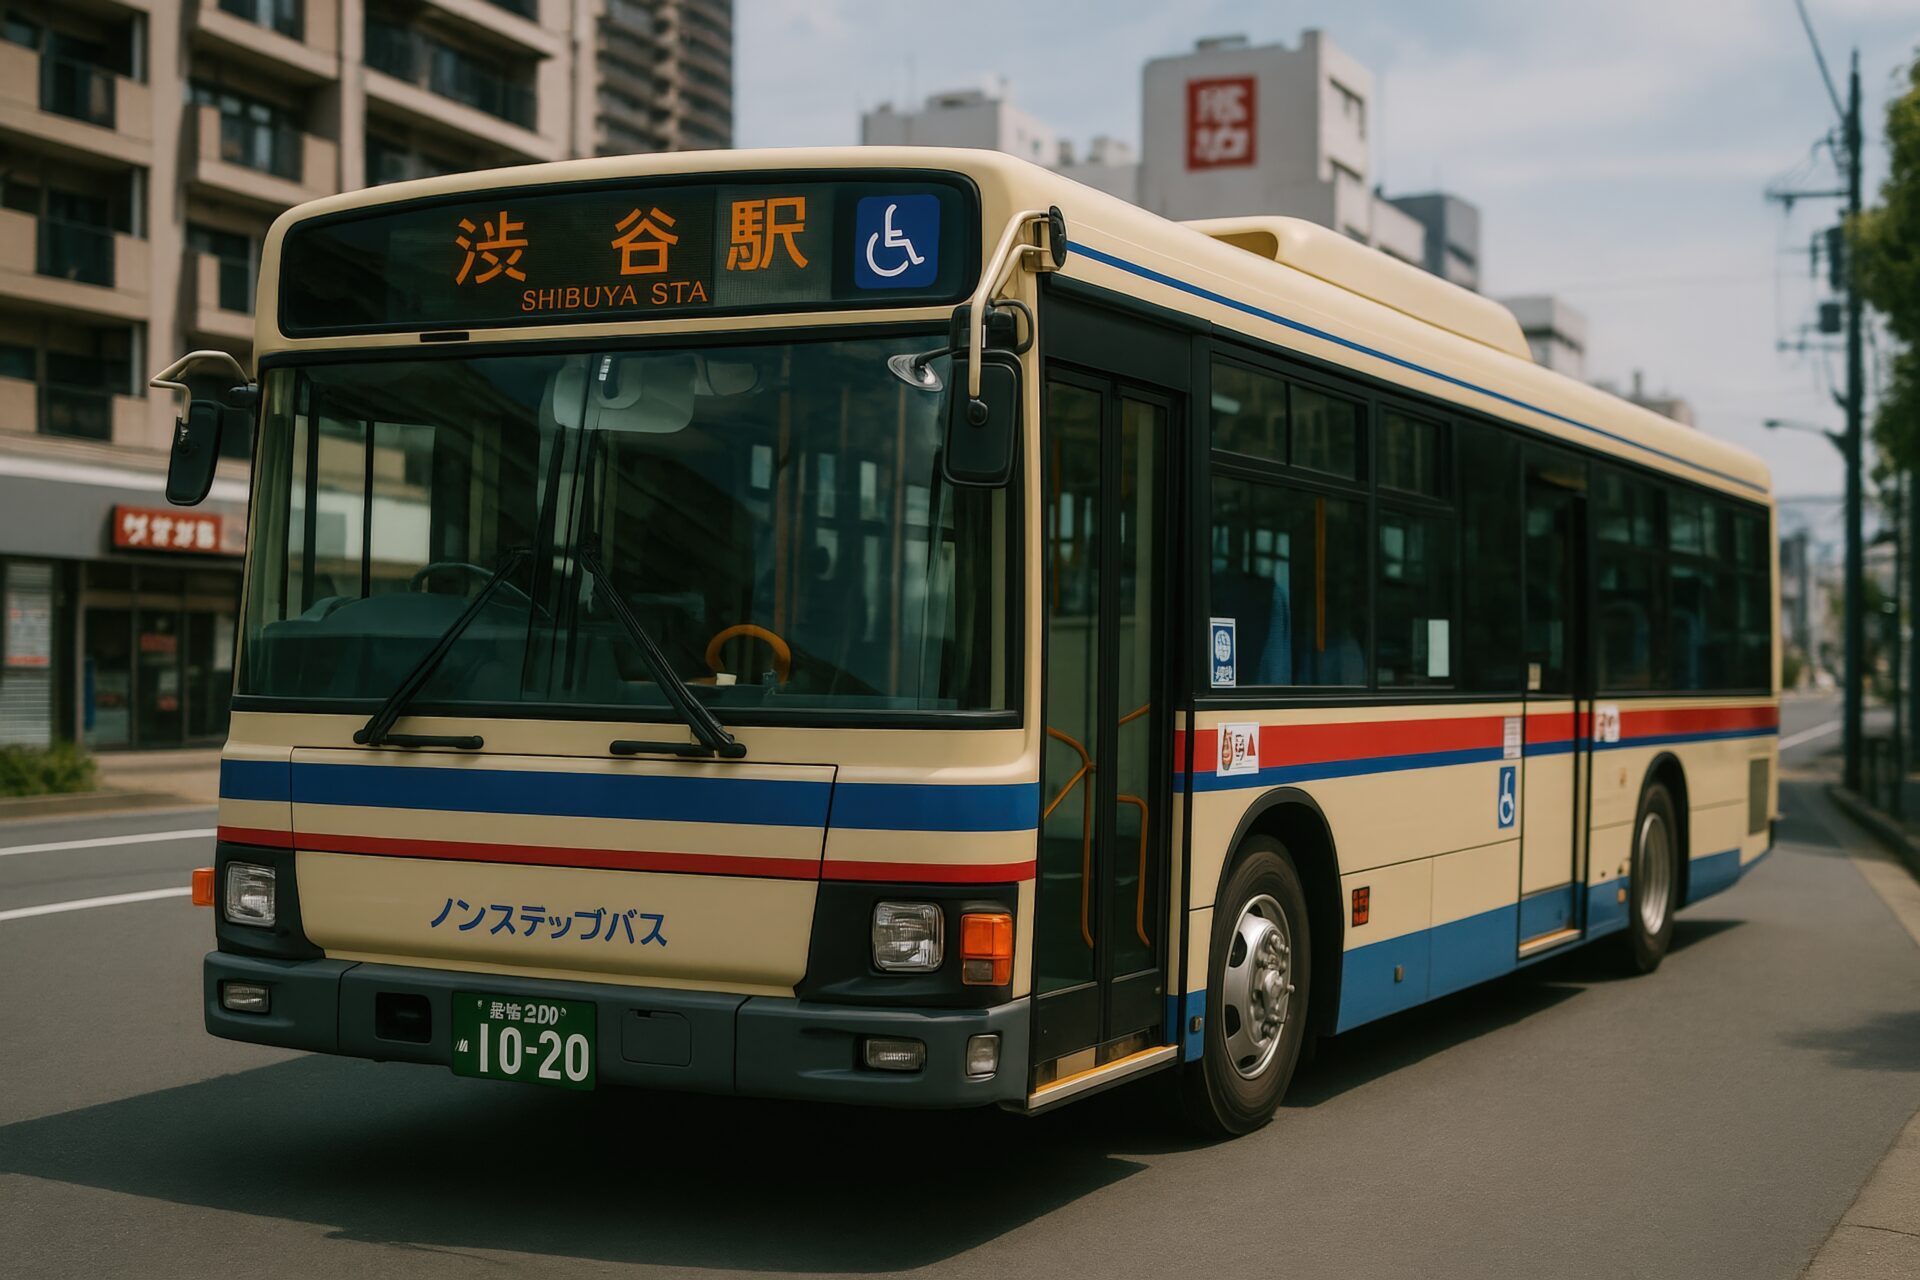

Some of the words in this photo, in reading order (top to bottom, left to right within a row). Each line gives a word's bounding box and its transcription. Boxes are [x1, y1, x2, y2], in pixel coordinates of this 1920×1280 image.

[521, 285, 638, 311] SHIBUYA
[651, 281, 708, 305] STA
[431, 898, 667, 946] ノンステップバス
[479, 1023, 590, 1082] 10-20
